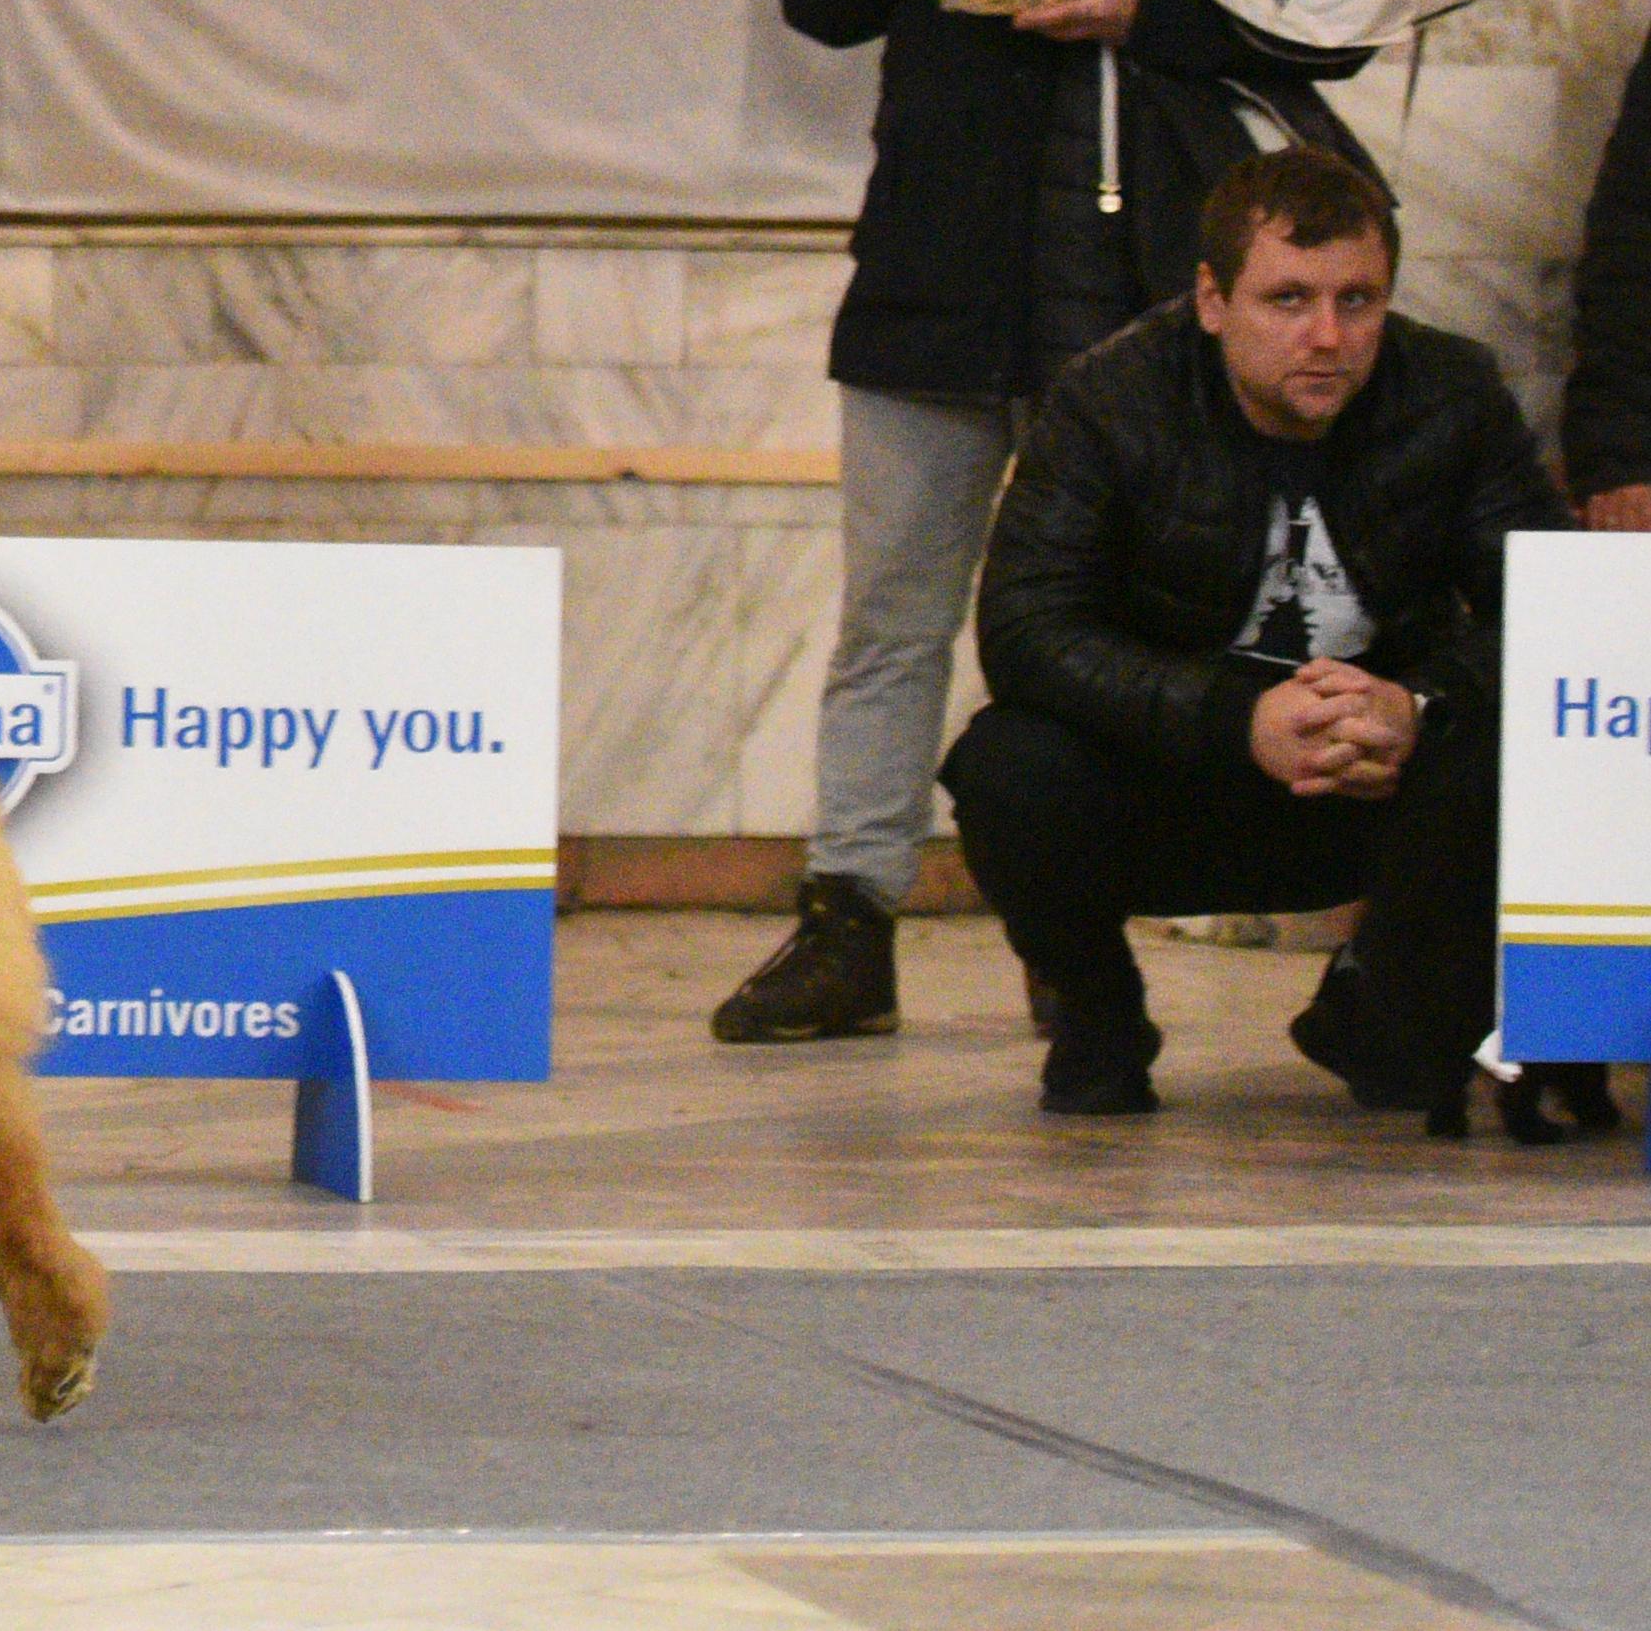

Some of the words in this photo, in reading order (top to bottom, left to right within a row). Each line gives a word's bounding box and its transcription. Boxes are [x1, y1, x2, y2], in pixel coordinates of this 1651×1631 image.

[121, 686, 339, 769] Happy
[362, 708, 506, 771] you.
[1554, 676, 1651, 758] Ha
